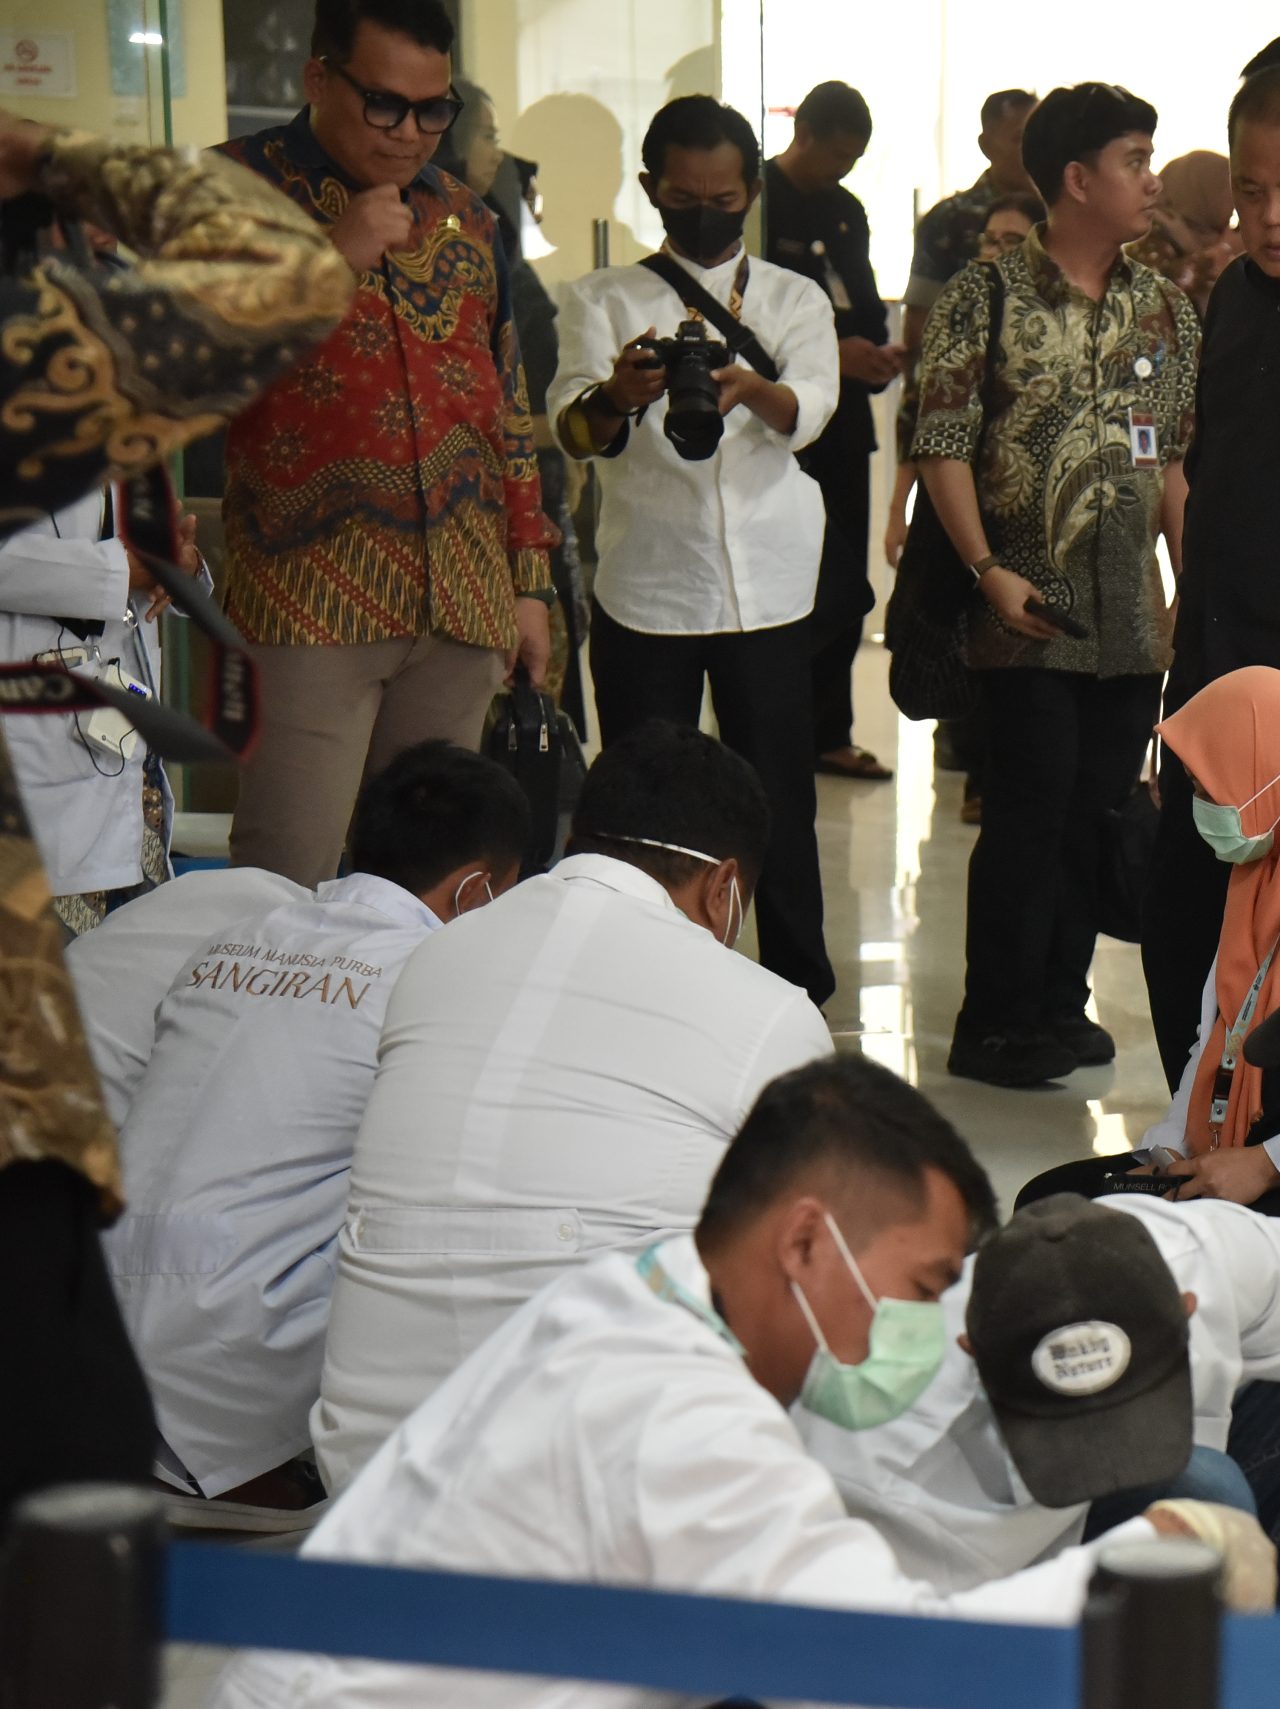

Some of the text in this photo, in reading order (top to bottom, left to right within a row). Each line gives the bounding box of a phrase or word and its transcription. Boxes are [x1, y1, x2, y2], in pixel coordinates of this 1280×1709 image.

[261, 949, 325, 967] MANUSIA
[330, 956, 382, 977] PURBA
[186, 960, 371, 1010] SANGIRAN
[1113, 1182, 1156, 1192] MUNSELL
